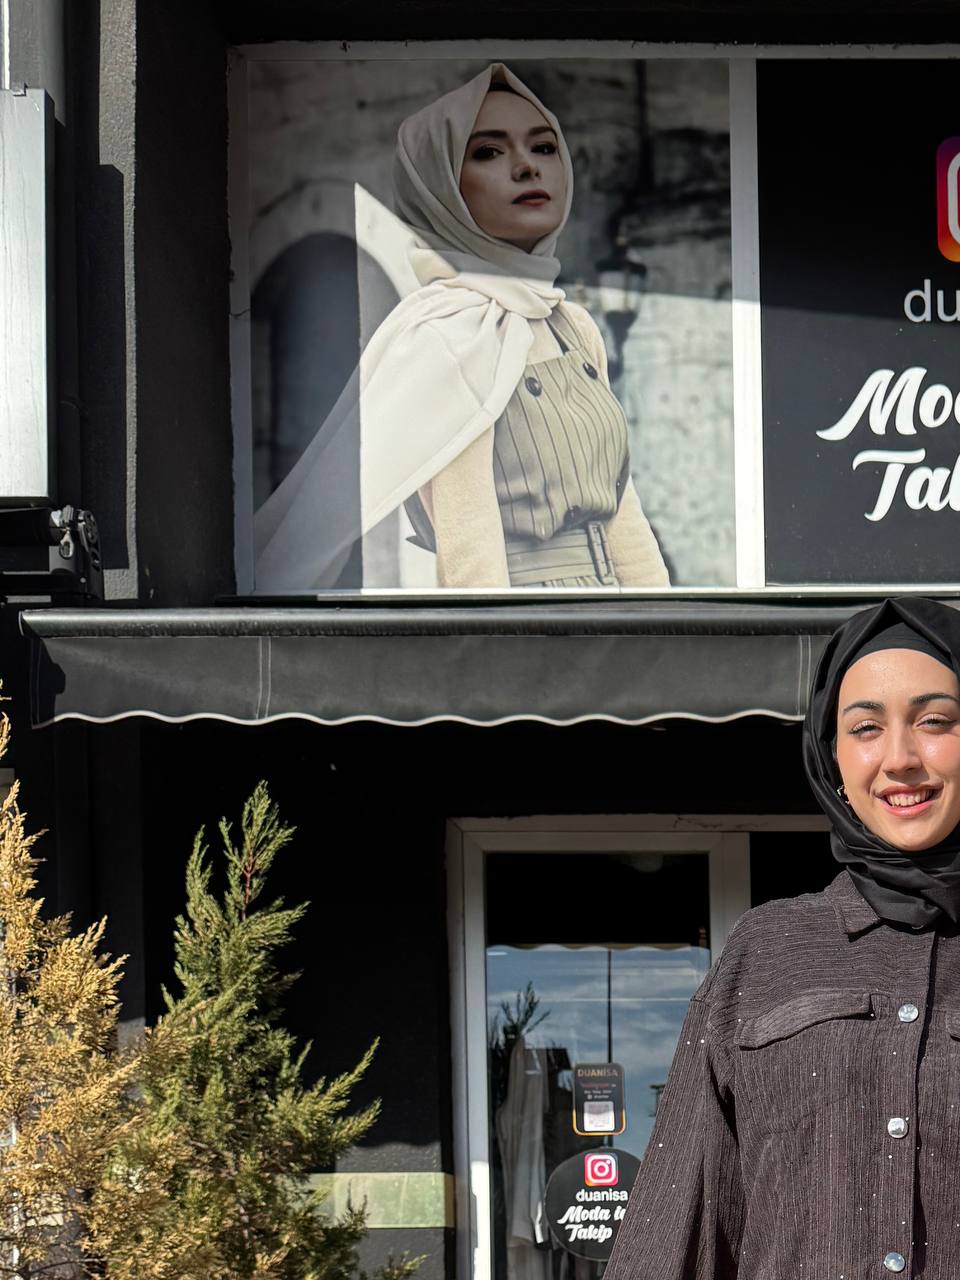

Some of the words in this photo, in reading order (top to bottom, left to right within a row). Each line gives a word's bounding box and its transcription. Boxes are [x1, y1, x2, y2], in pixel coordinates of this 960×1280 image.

[575, 1188, 628, 1202] duanisa
[557, 1206, 611, 1224] Moda
[564, 1224, 612, 1243] Takip
